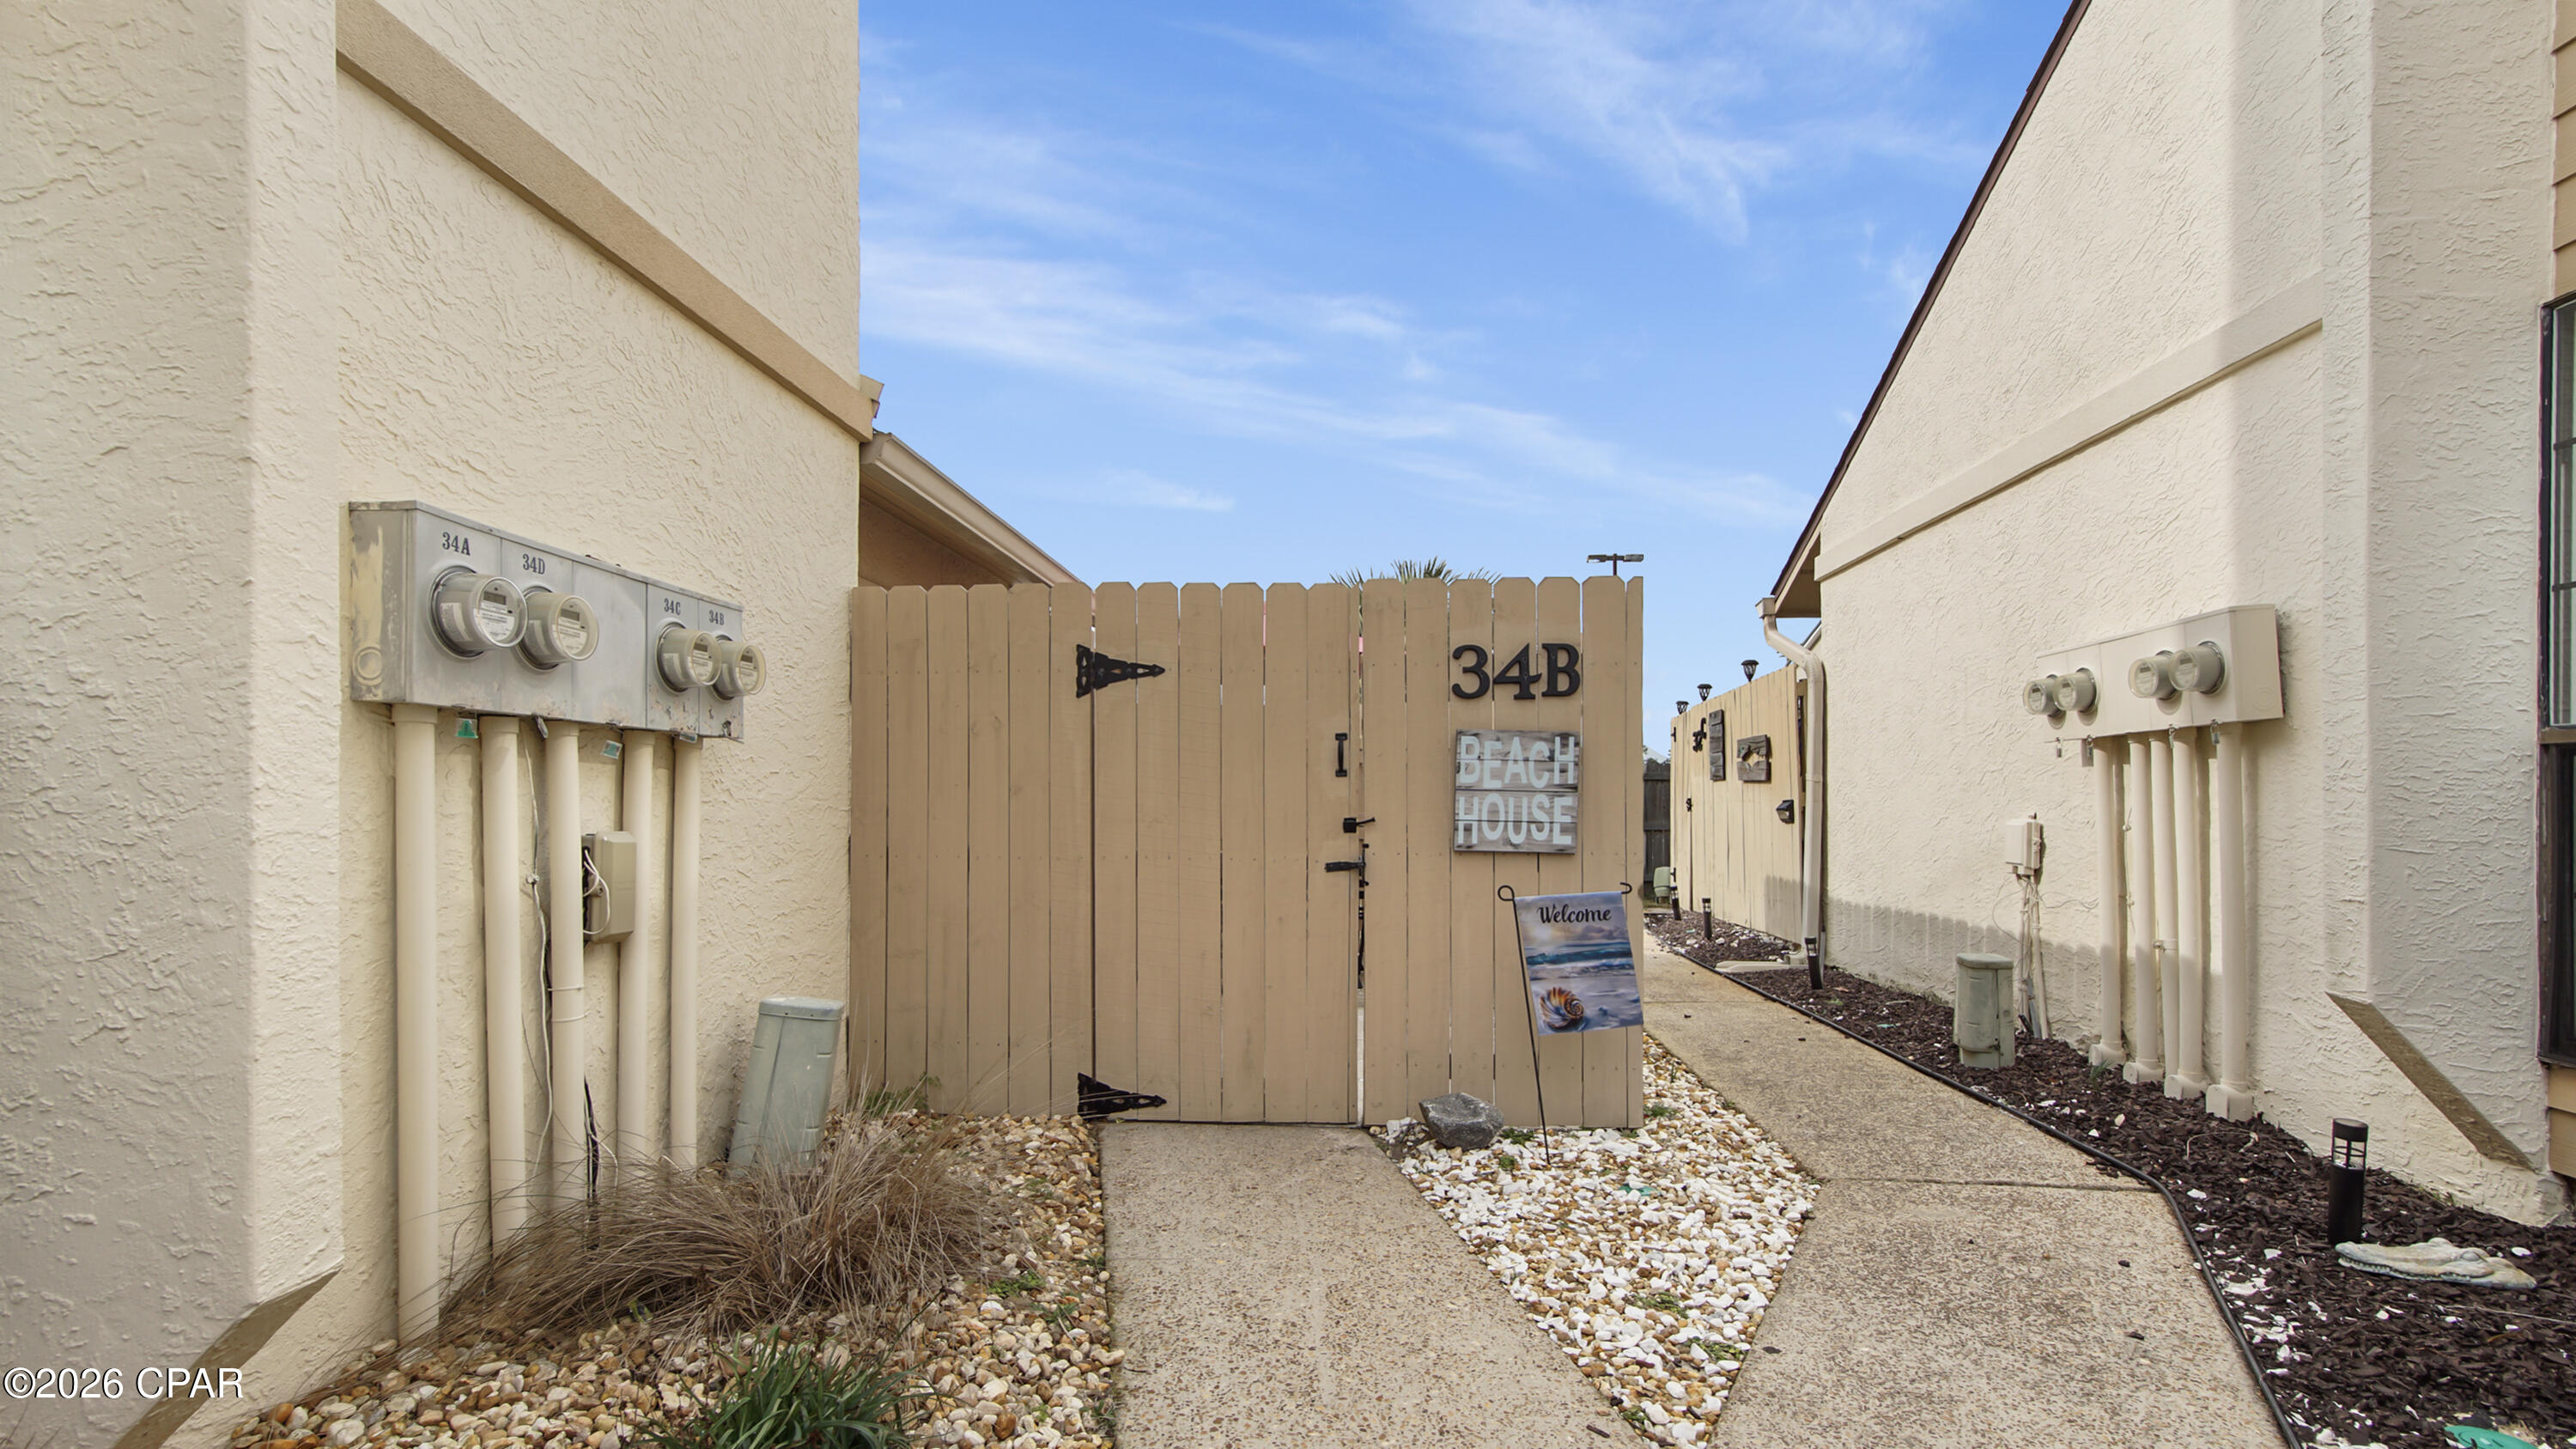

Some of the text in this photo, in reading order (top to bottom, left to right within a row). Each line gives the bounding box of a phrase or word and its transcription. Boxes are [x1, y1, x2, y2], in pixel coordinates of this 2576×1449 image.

[442, 532, 471, 556] 34A
[522, 553, 545, 575] 34D
[664, 598, 681, 615] 34C
[708, 610, 725, 625] 34B
[1452, 643, 1580, 700] 34B
[1459, 736, 1575, 788] BEACH
[1458, 793, 1572, 844] HOUSE
[1537, 904, 1612, 923] Welcome
